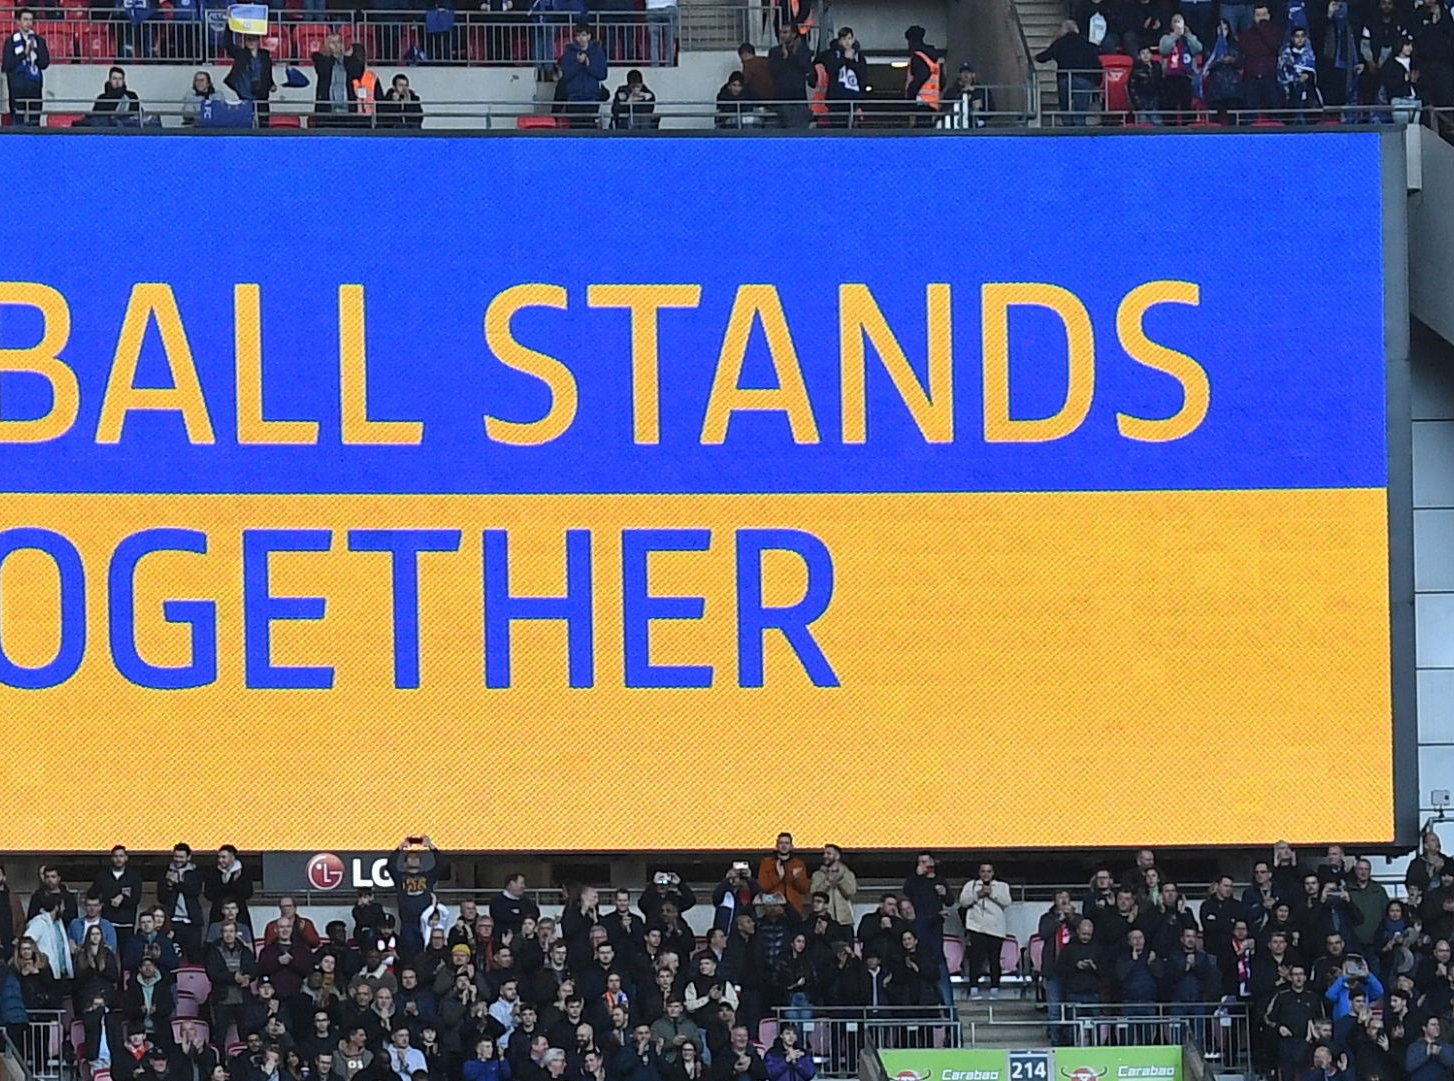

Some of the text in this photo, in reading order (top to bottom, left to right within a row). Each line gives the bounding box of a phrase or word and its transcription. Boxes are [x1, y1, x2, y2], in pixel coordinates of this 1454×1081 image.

[486, 283, 1209, 443] STANDS
[352, 858, 395, 888] LG
[941, 1069, 999, 1081] Carabao
[1011, 1062, 1047, 1079] 214
[1117, 1065, 1176, 1078] Carabao
